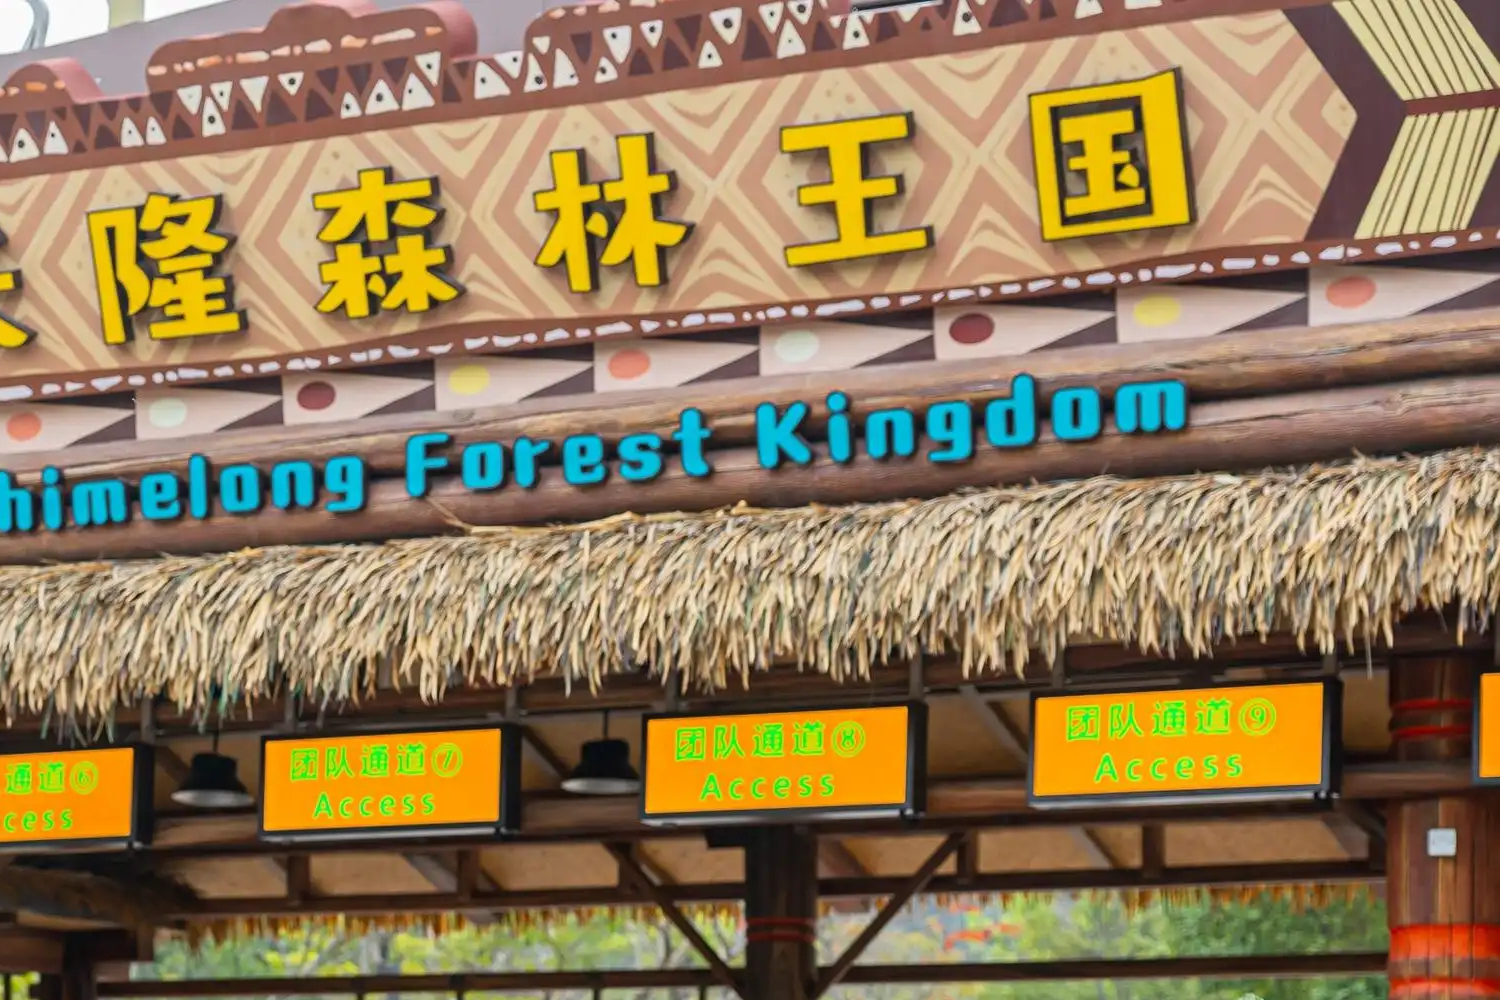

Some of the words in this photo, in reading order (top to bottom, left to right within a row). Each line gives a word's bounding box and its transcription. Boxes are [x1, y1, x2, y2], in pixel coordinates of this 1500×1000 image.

[404, 407, 713, 498] Forest
[754, 373, 1188, 471] Kingdom
[1092, 752, 1244, 784] Access
[698, 771, 836, 802] Access
[311, 790, 436, 820] Access
